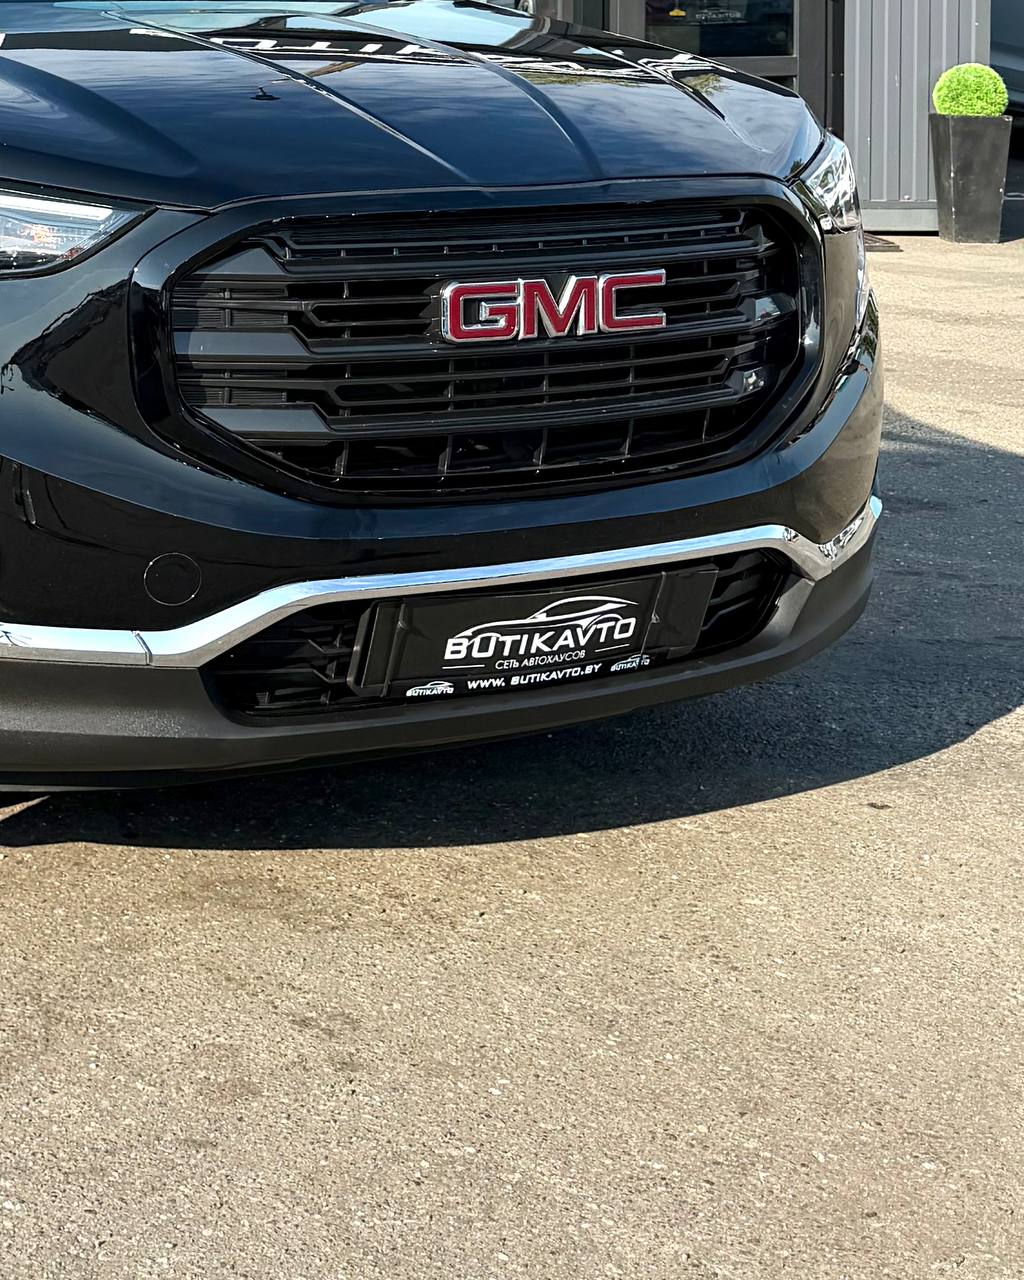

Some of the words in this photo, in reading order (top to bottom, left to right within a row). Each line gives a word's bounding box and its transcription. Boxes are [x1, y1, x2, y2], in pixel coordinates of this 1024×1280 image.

[440, 268, 667, 343] GMC
[443, 616, 637, 661] BUTIKAVTO
[495, 658, 520, 670] СЕТЬ
[521, 649, 586, 668] АВТОХАУСОВ
[467, 677, 506, 690] WWW.
[510, 662, 603, 686] BUTIKAVTO.BY
[405, 686, 455, 697] BUTIKAVTO
